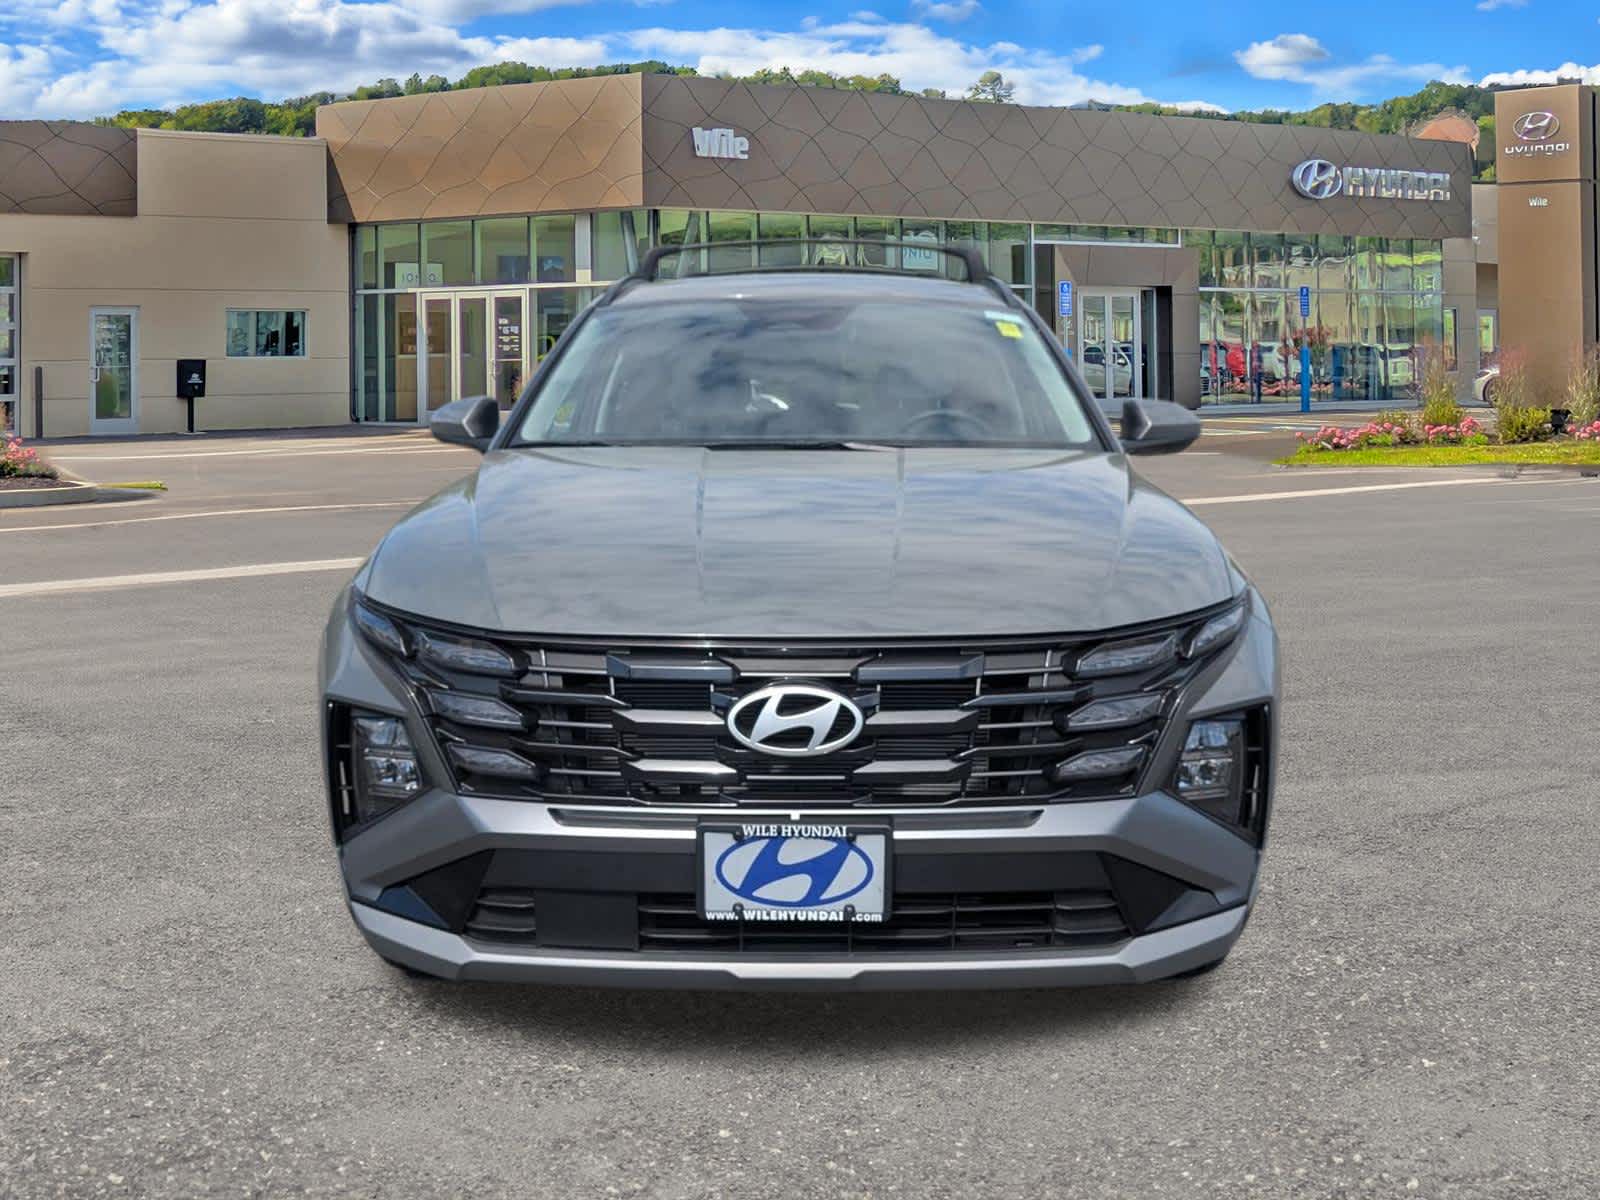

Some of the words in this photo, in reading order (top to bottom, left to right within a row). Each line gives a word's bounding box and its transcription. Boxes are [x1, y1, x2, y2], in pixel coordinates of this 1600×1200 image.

[692, 127, 749, 159] Wile
[1343, 167, 1450, 200] HYUNDAI
[742, 824, 778, 837] WILE
[781, 825, 848, 838] HYUNDAI
[706, 910, 739, 921] www.
[743, 909, 844, 922] WILEHYUNDAI
[851, 911, 882, 922] .com
